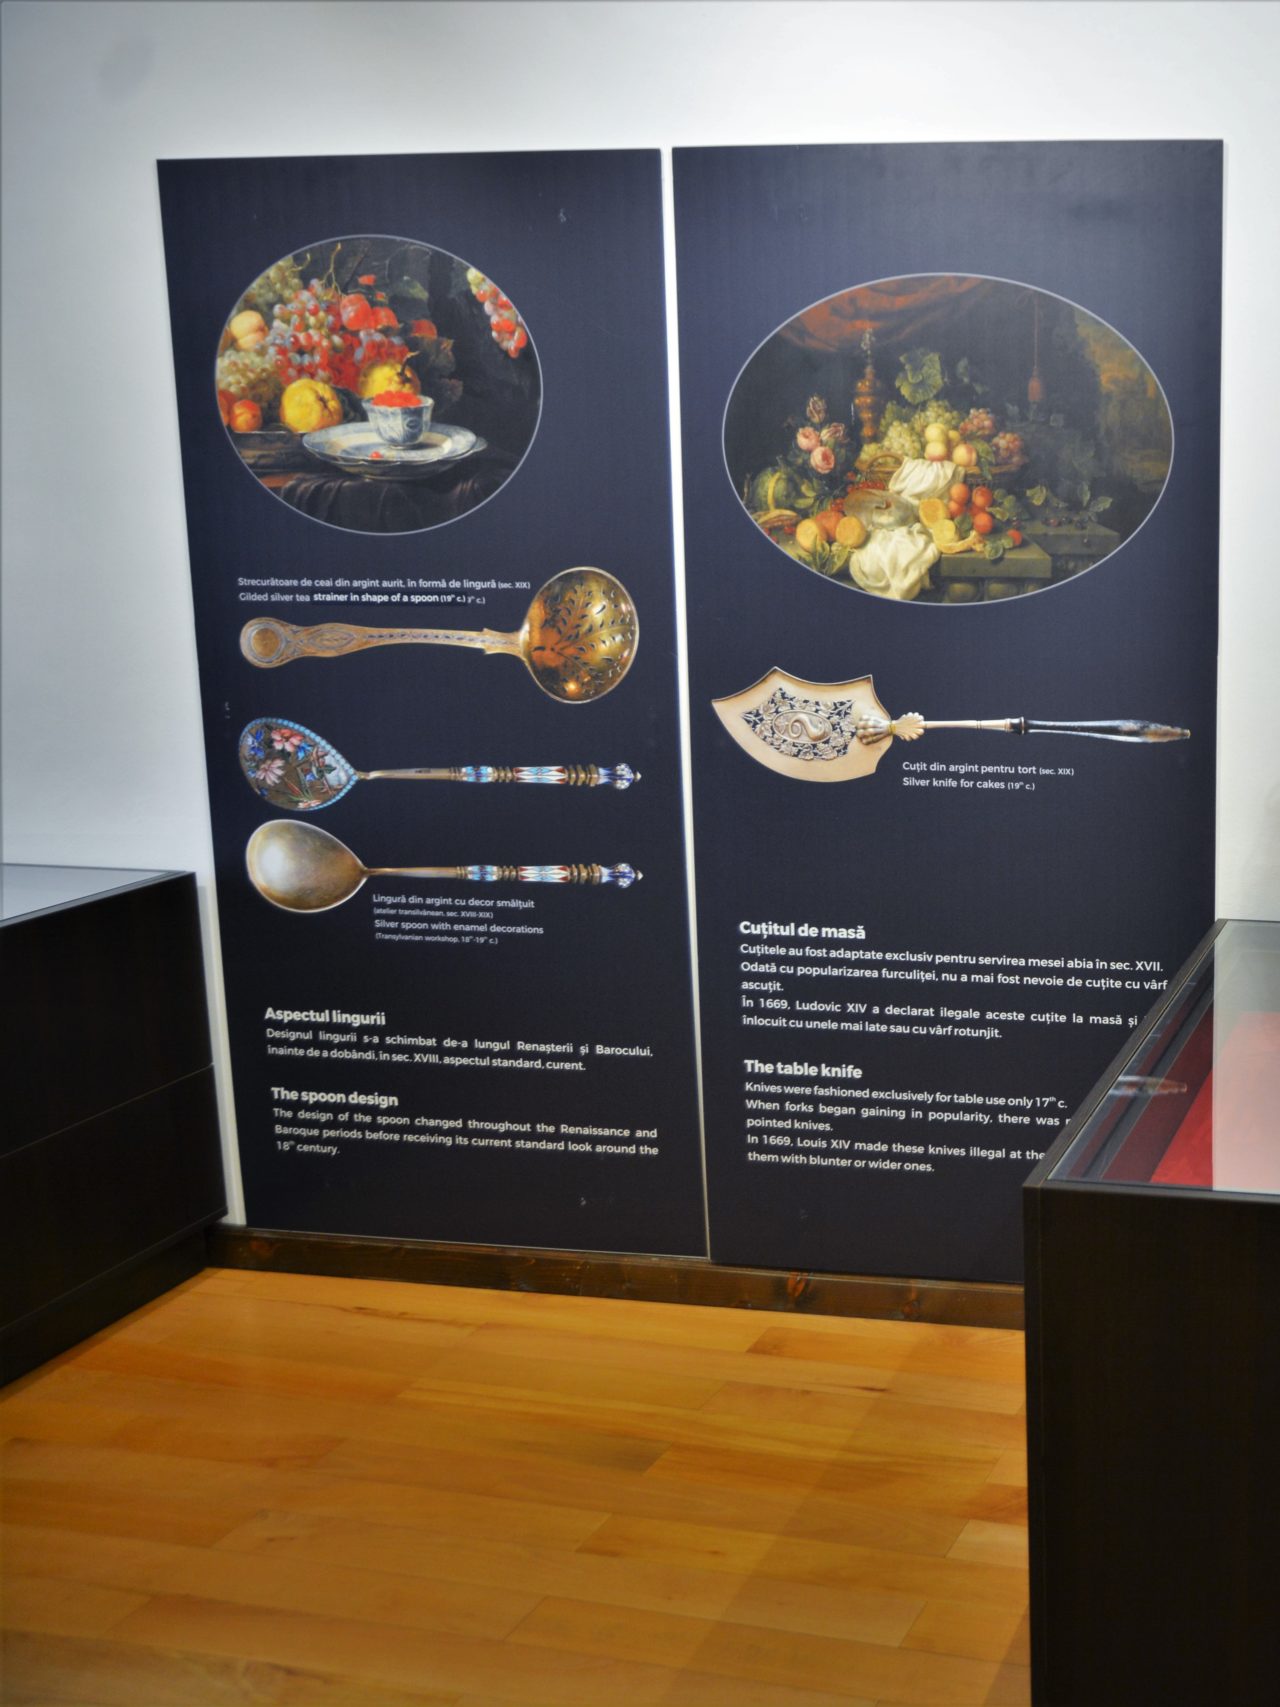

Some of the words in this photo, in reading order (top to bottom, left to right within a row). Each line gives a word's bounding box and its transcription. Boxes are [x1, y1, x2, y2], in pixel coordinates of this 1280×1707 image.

[929, 762, 946, 771] din
[948, 763, 979, 773] argint
[980, 765, 1014, 774] pentru
[1017, 766, 1036, 774] tort
[902, 777, 930, 786] Silver
[932, 778, 957, 787] knife
[960, 778, 974, 787] for
[976, 779, 1005, 788] cakes
[408, 895, 423, 903] din
[425, 896, 452, 906] argint
[467, 897, 494, 906] decor
[374, 919, 399, 928] Silver
[400, 922, 429, 930] spoon
[430, 922, 451, 930] with
[489, 924, 544, 934] decorations
[739, 921, 795, 938] Cuțitul
[797, 923, 819, 937] de
[821, 925, 865, 939] masă
[740, 943, 786, 956] Cuțitele
[788, 948, 803, 956] au
[805, 946, 827, 957] fost
[829, 948, 883, 960] adaptate
[885, 951, 933, 962] exclusiv
[935, 954, 976, 964] pentru
[978, 955, 1025, 966] servirea
[1028, 957, 1064, 967] mesei
[1066, 958, 1093, 968] abia
[1095, 958, 1107, 969] în
[1110, 961, 1133, 970] sec.
[1135, 961, 1164, 971] XVII.
[264, 1007, 330, 1022] Aspectul
[332, 1010, 385, 1026] lingurii
[743, 1059, 774, 1073] The
[776, 1062, 818, 1076] table
[821, 1063, 862, 1078] knife
[271, 1087, 299, 1100] The
[300, 1091, 346, 1104] spoon
[348, 1091, 398, 1108] design
[745, 1082, 782, 1093] Knives
[783, 1085, 812, 1094] were
[813, 1085, 870, 1098] fashioned
[871, 1090, 934, 1103] exclusively
[935, 1091, 952, 1102] for
[953, 1093, 984, 1104] table
[985, 1096, 1006, 1105] use
[1007, 1096, 1033, 1108] only
[1057, 1100, 1068, 1108] c.
[745, 1099, 780, 1110] When
[784, 1101, 814, 1112] forks
[818, 1103, 856, 1116] began
[860, 1106, 906, 1119] gaining
[911, 1108, 922, 1118] in
[998, 1113, 1030, 1124] there
[1035, 1117, 1060, 1125] was
[273, 1108, 293, 1117] The
[297, 1109, 333, 1121] design
[337, 1111, 350, 1121] of
[353, 1113, 372, 1122] the
[376, 1116, 410, 1125] spoon
[414, 1116, 463, 1129] changed
[467, 1119, 531, 1132] throughout
[536, 1123, 555, 1133] the
[560, 1124, 630, 1136] Renaissance
[635, 1128, 657, 1138] and
[746, 1117, 792, 1128] pointed
[794, 1119, 834, 1130] knives.
[275, 1124, 319, 1136] Baroque
[322, 1128, 362, 1138] periods
[365, 1130, 400, 1140] before
[403, 1133, 452, 1146] receiving
[455, 1135, 469, 1145] its
[471, 1138, 512, 1147] current
[515, 1139, 564, 1150] standard
[568, 1141, 592, 1151] look
[595, 1144, 636, 1154] around
[639, 1145, 659, 1155] the
[747, 1134, 758, 1143] In
[797, 1137, 827, 1148] Louis
[830, 1139, 850, 1149] XIV
[854, 1141, 888, 1151] made
[892, 1142, 924, 1153] these
[928, 1144, 966, 1156] knives
[970, 1146, 1005, 1159] illegal
[1009, 1150, 1022, 1158] at
[747, 1151, 779, 1162] them
[780, 1153, 807, 1164] with
[809, 1155, 852, 1166] blunter
[853, 1159, 866, 1167] or
[868, 1159, 902, 1169] wider
[903, 1162, 935, 1171] ones.
